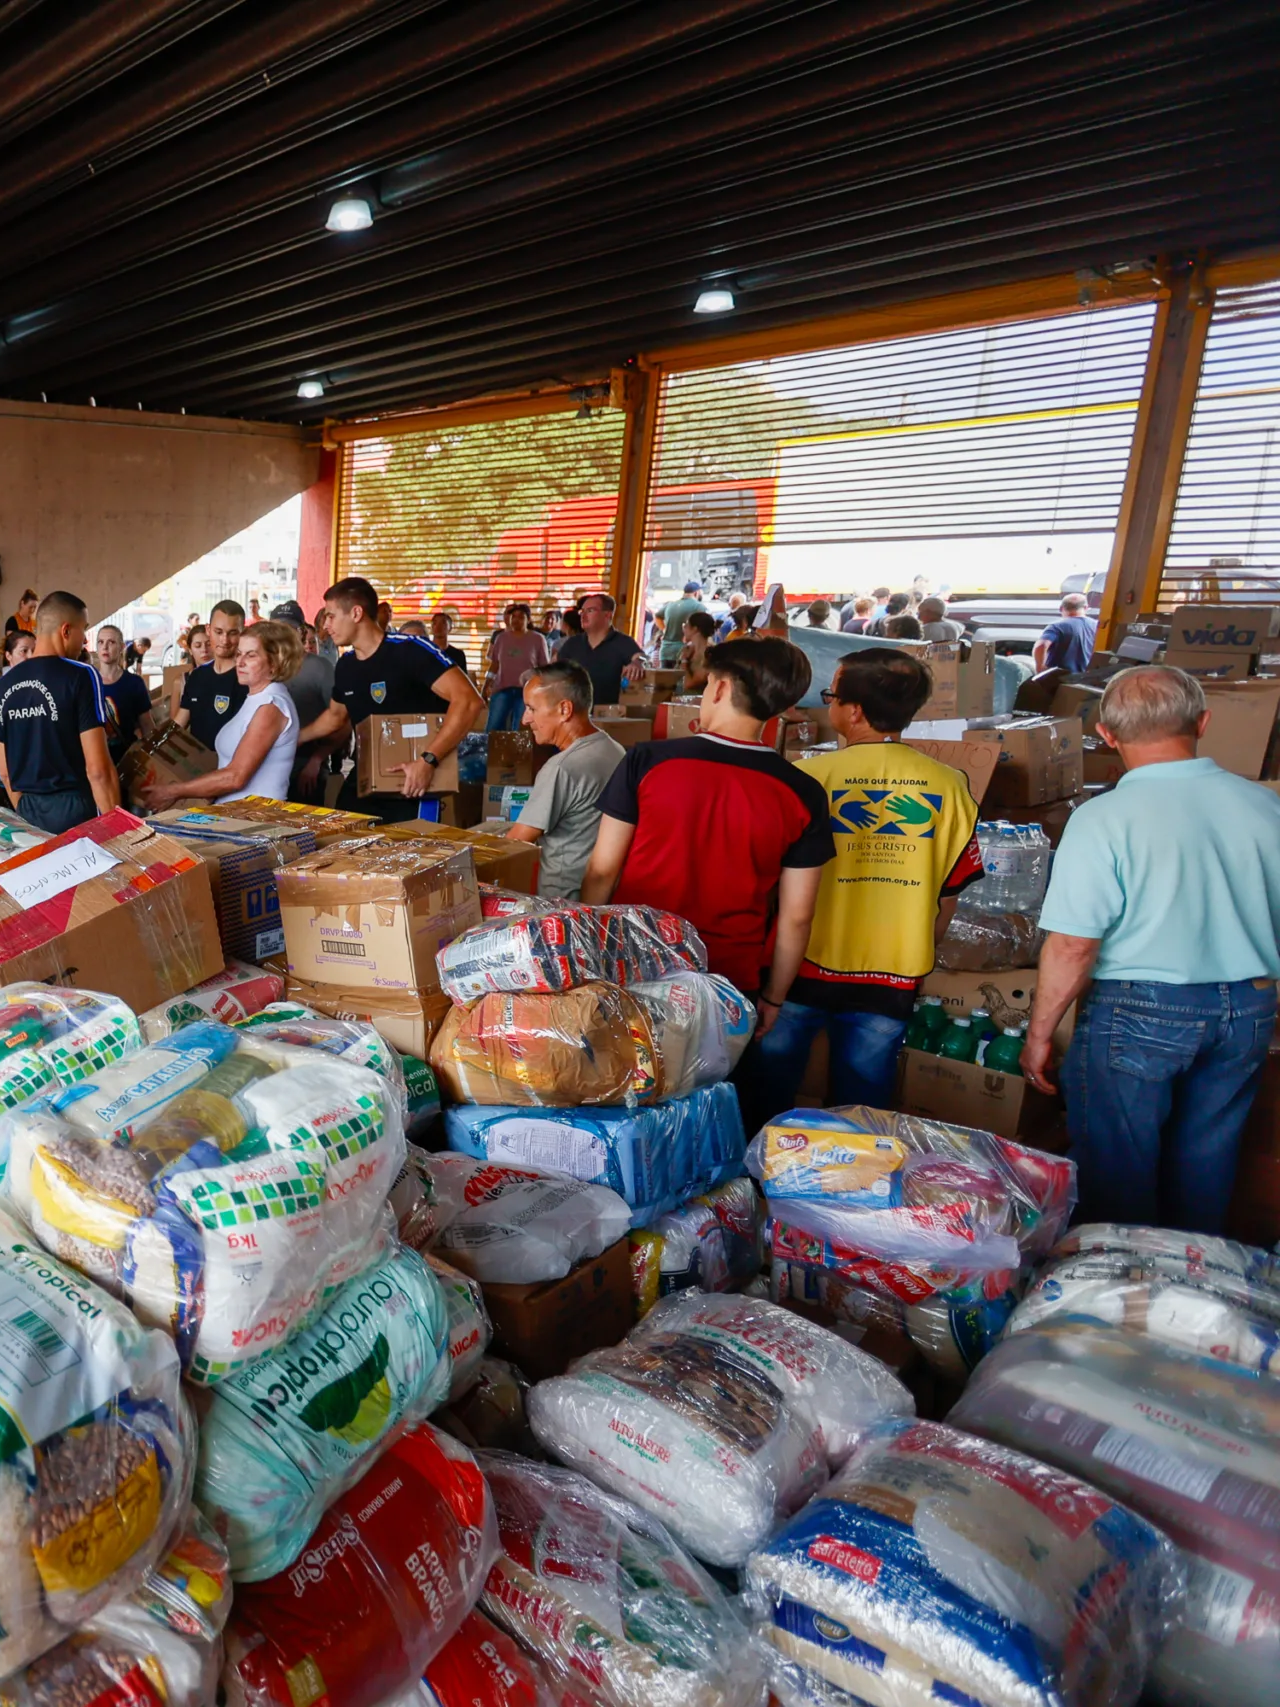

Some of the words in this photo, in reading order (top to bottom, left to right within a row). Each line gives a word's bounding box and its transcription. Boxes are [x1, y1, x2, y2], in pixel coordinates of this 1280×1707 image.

[1182, 624, 1257, 646] vida
[4, 687, 13, 700] DE
[8, 703, 47, 720] PARANÁ
[844, 777, 869, 785] MÃOS
[891, 778, 929, 787] AJUDAM
[846, 842, 872, 852] JESUS
[874, 842, 917, 853] CRISTO
[837, 876, 921, 887] www.mormon.org.br
[779, 1134, 806, 1149] Ninfa
[811, 1146, 856, 1168] Leite
[227, 1232, 258, 1250] 1kg
[608, 1416, 635, 1442] ALTO
[634, 1430, 672, 1464] ALEGRE
[381, 1476, 404, 1503] ARROZ
[357, 1495, 387, 1524] BRANCO
[288, 1513, 360, 1598] SaborSul
[404, 1552, 446, 1633] BRANCO
